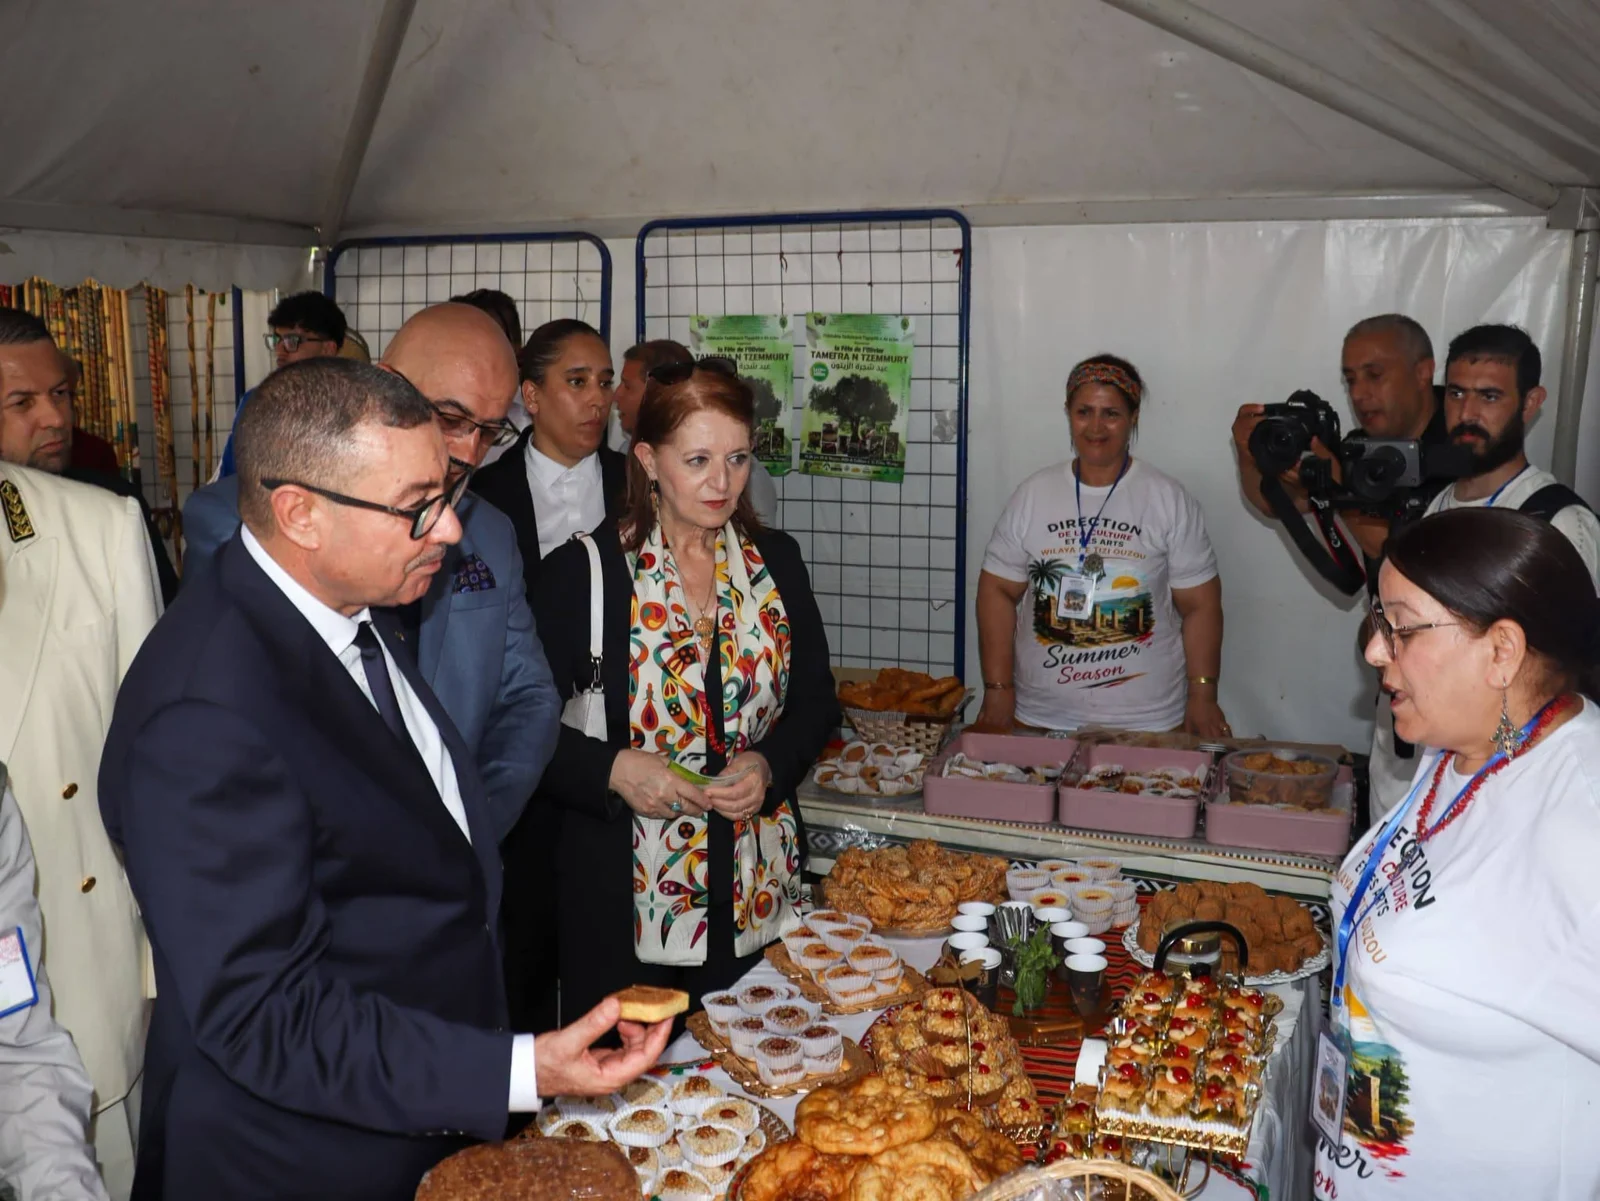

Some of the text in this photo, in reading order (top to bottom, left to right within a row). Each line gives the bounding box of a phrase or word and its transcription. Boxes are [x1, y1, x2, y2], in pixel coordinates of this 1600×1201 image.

[744, 353, 790, 361] TZEMMURT
[861, 354, 909, 364] TZEMMURT
[1047, 516, 1142, 537] DIRECTION
[1058, 530, 1072, 539] DE
[1089, 529, 1133, 541] CULTURE
[1099, 538, 1124, 548] ARTS
[1041, 547, 1076, 556] WILAYA
[1113, 547, 1147, 560] OUZOU
[1043, 643, 1141, 669] Summer
[1057, 665, 1126, 684] Season
[1361, 916, 1388, 964] OUZOU
